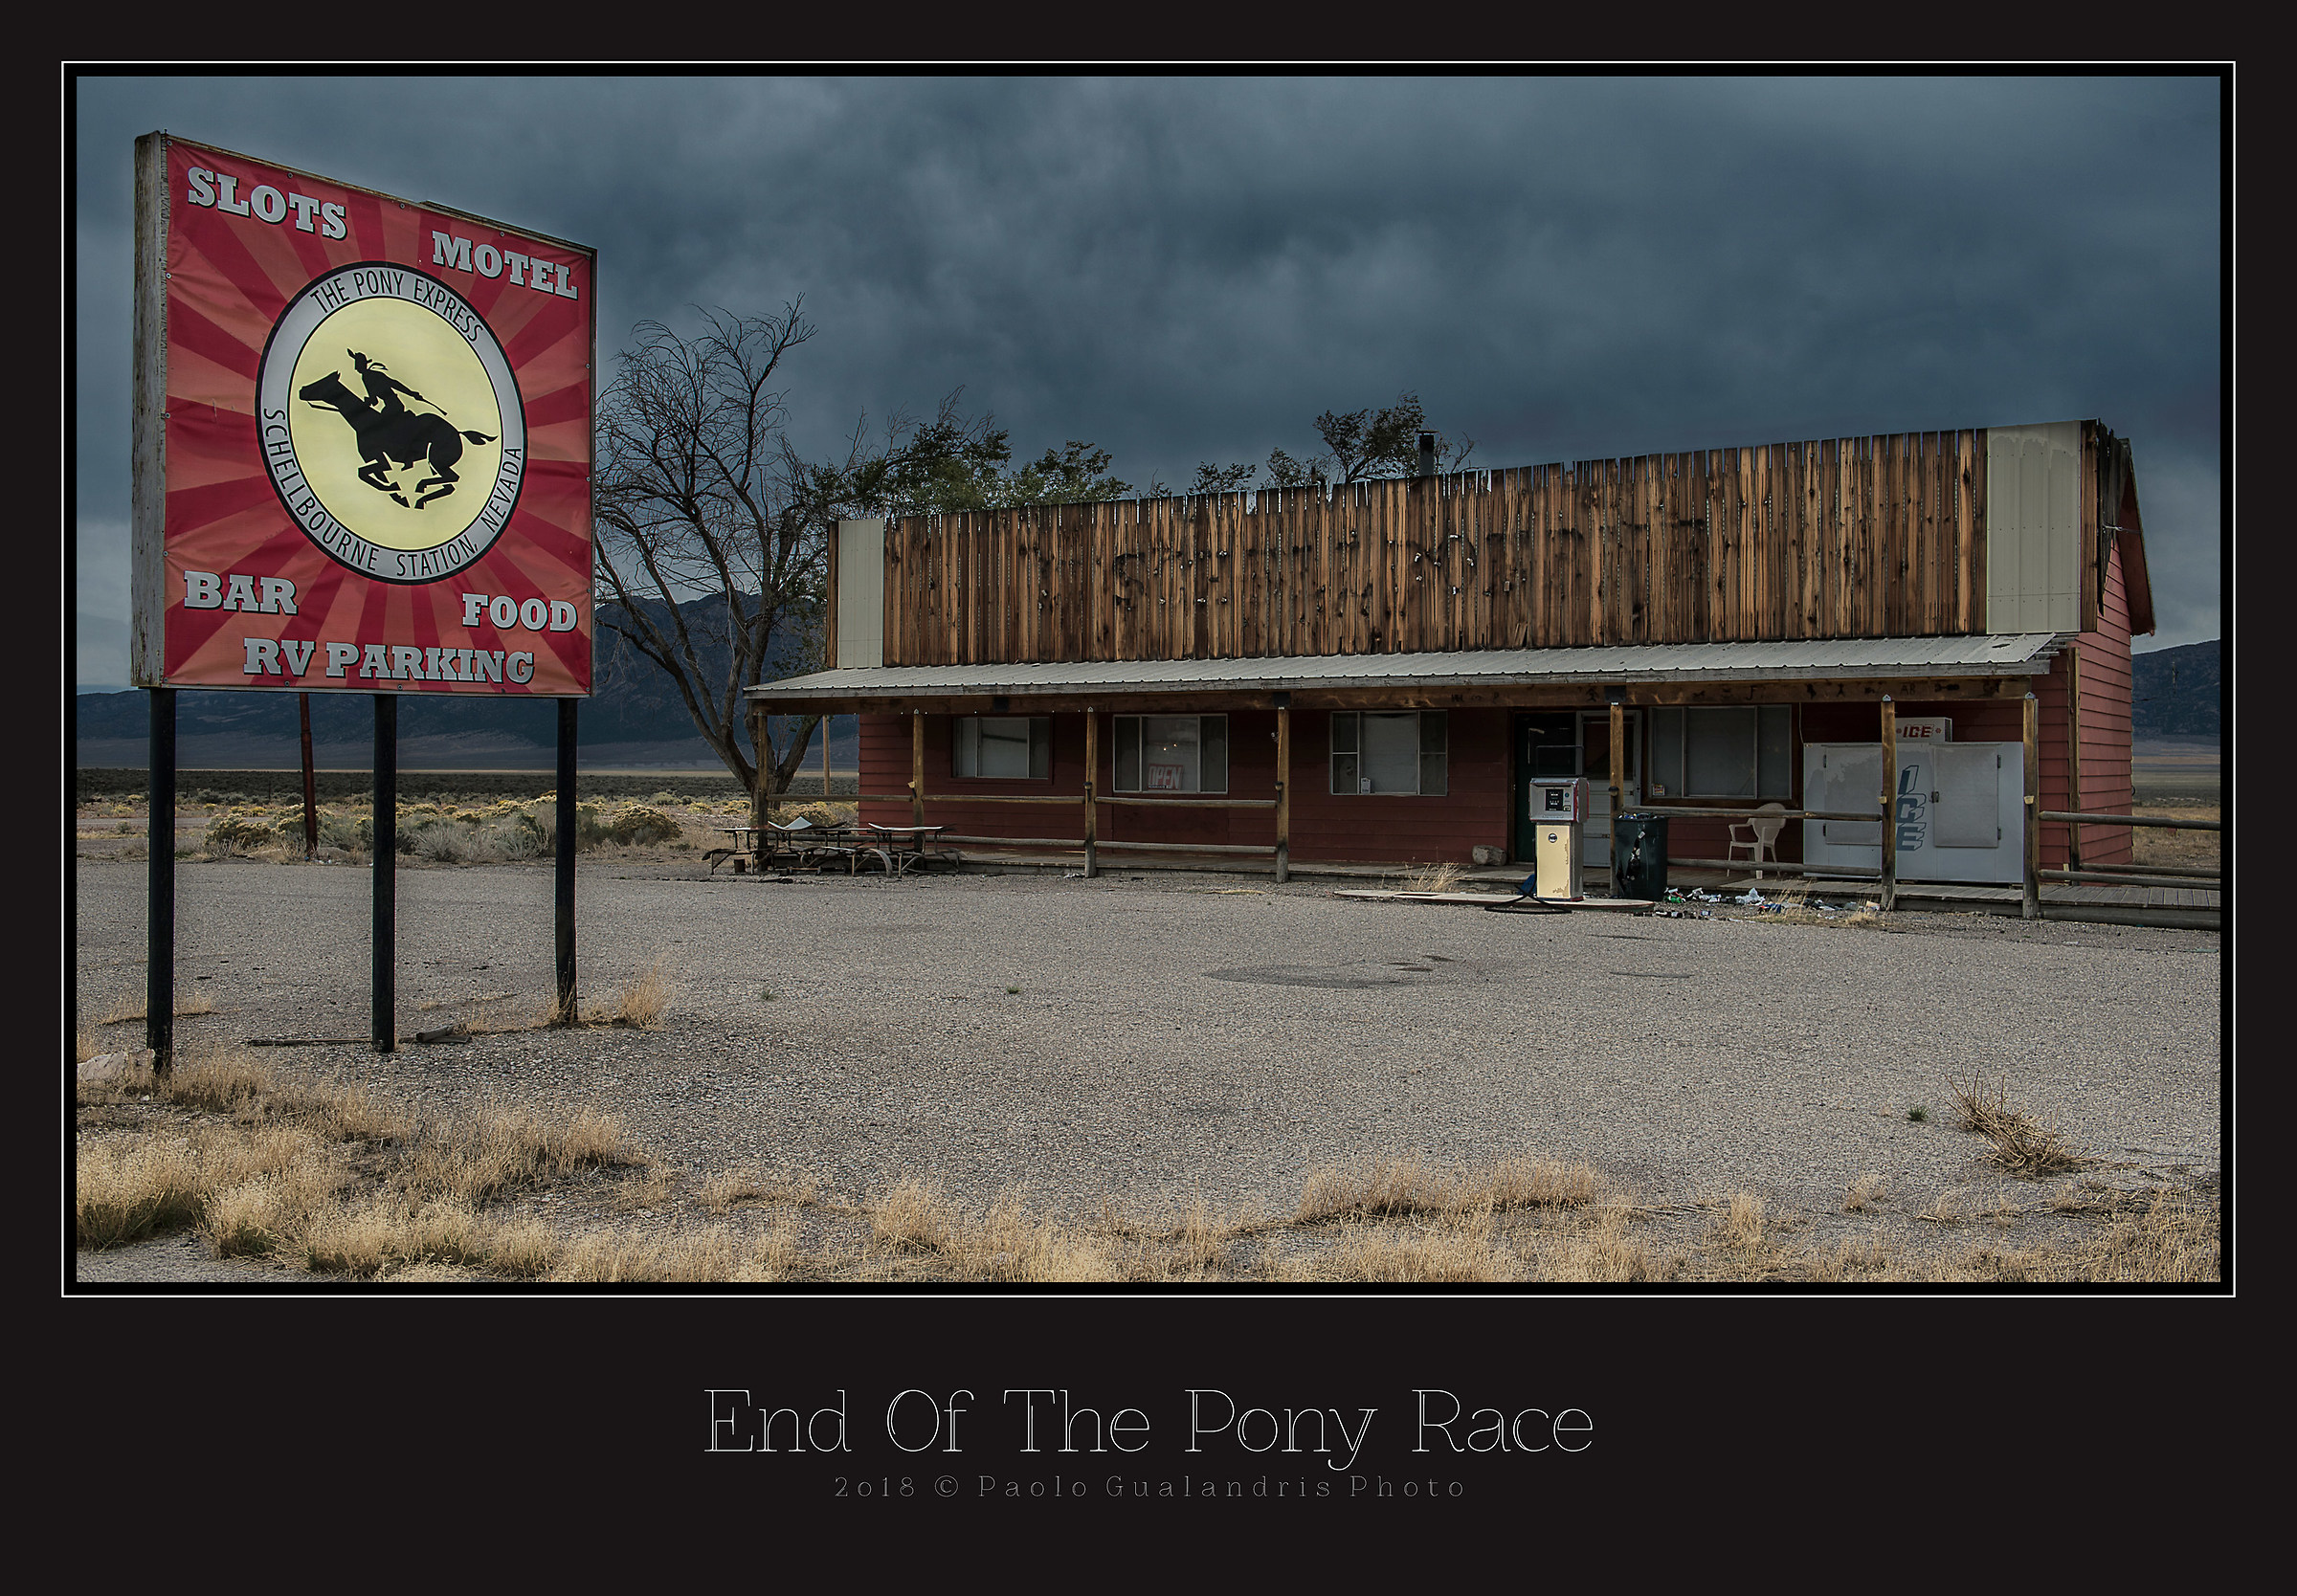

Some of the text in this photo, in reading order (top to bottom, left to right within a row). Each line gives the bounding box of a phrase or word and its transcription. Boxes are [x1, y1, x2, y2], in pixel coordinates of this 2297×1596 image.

[187, 166, 347, 240] SLOTS
[431, 231, 579, 300] MOTEL
[309, 270, 483, 342] THE PONY EXPRESS
[263, 408, 522, 577] SCHELLBOURNE STATION, NEVADA
[184, 570, 299, 616] BAR
[462, 592, 578, 632] FOOD
[243, 637, 535, 685] RV PARKING
[1902, 723, 1934, 738] ICE
[1148, 765, 1182, 789] OPEN
[1896, 765, 1927, 852] ICE
